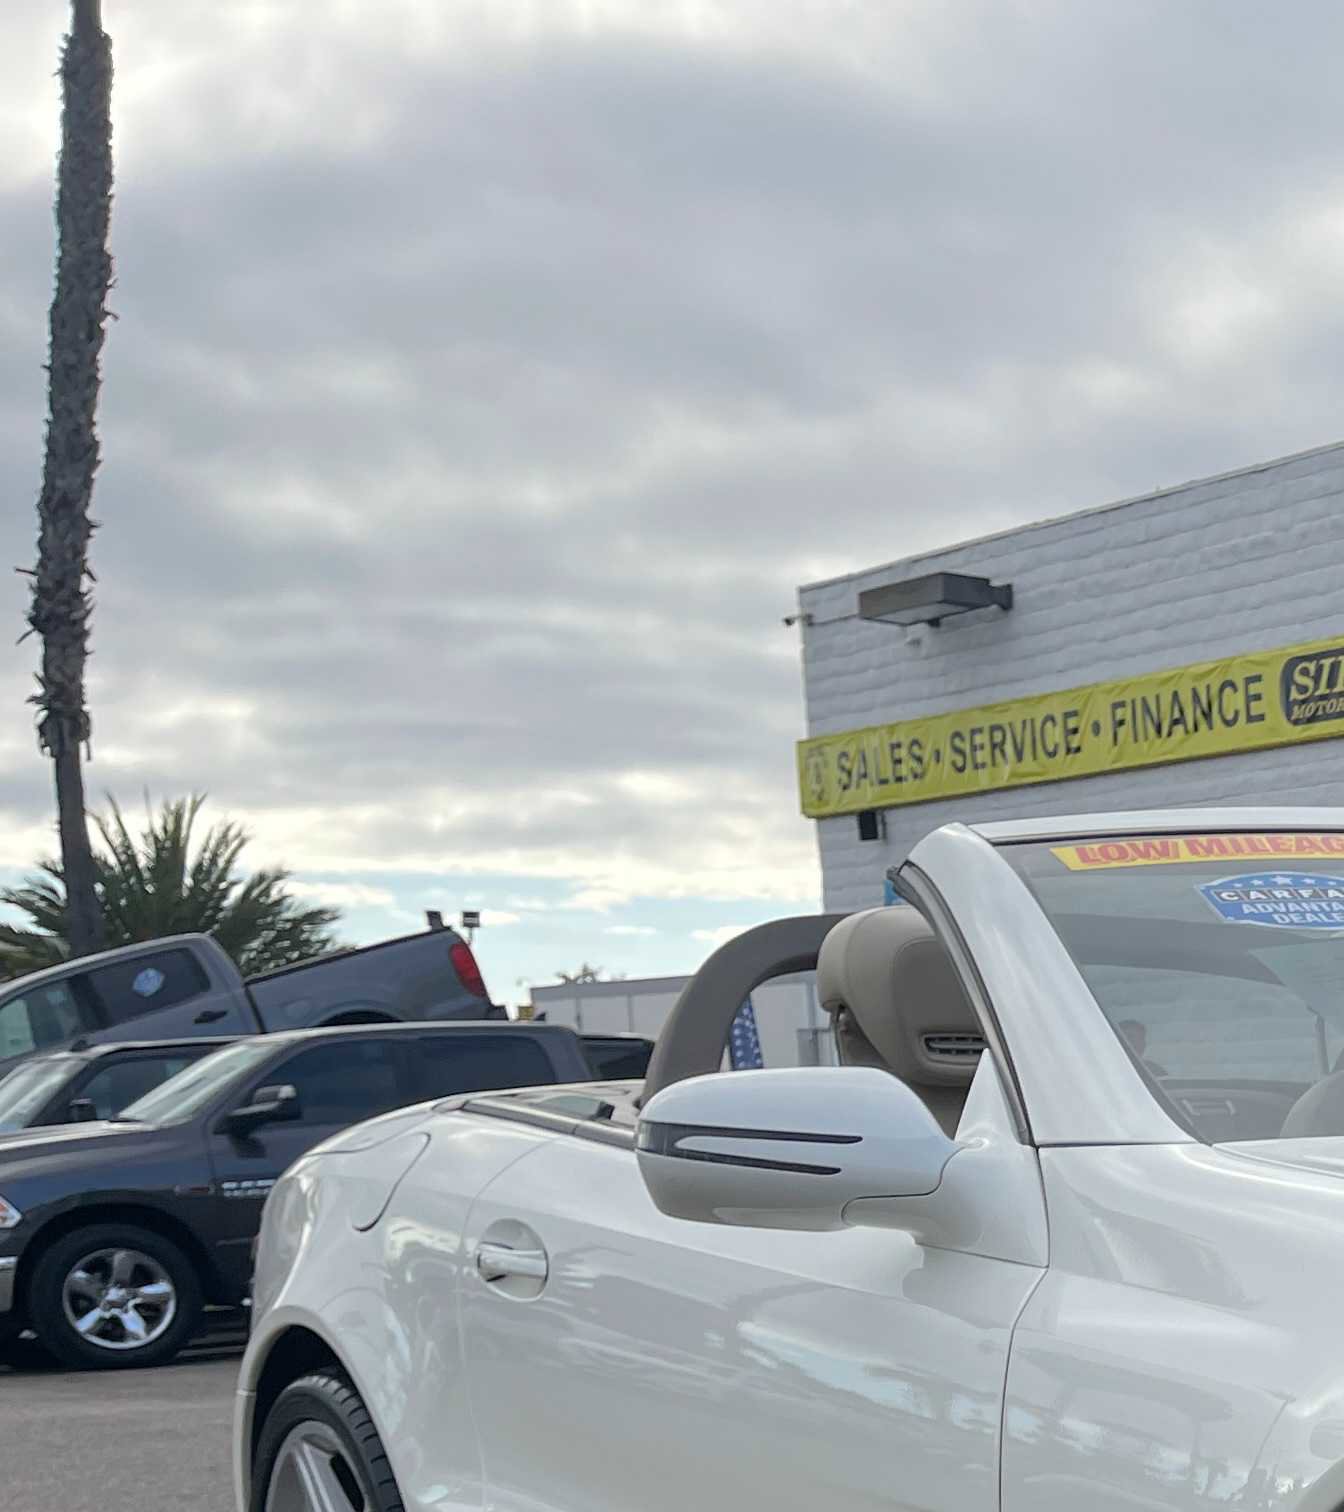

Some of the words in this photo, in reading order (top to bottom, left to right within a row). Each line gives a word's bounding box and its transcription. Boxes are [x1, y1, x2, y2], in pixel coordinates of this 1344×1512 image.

[837, 738, 926, 791] SALES
[949, 709, 1081, 774] SERVICE
[1110, 674, 1265, 746] FINANCE
[1075, 842, 1179, 866] LOW
